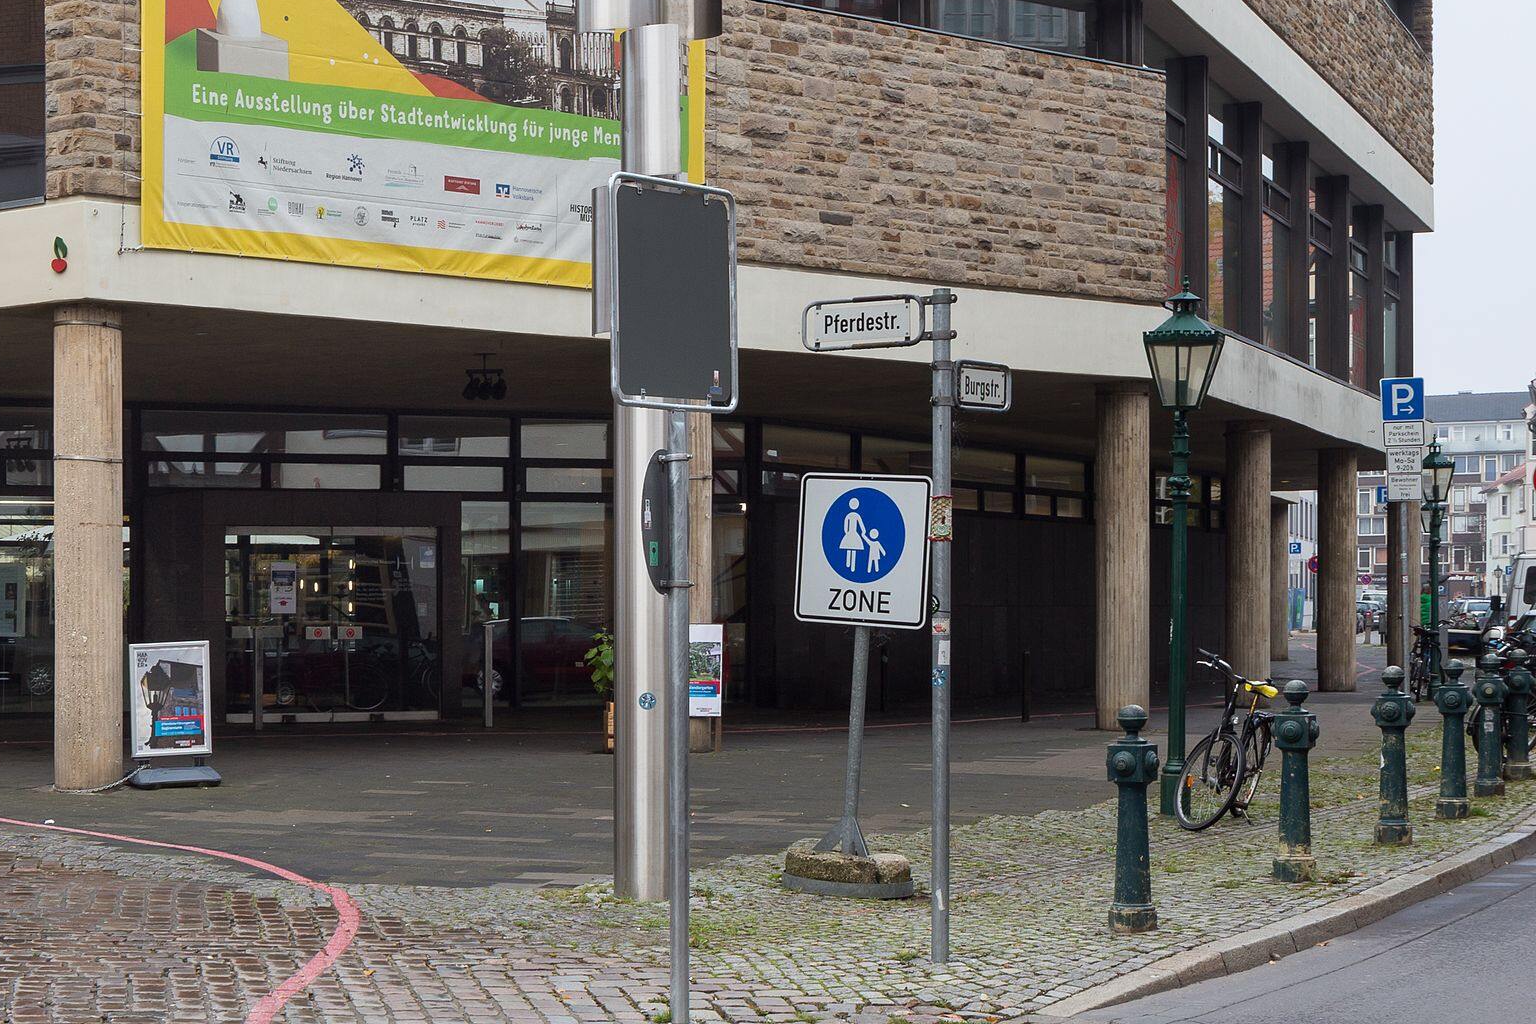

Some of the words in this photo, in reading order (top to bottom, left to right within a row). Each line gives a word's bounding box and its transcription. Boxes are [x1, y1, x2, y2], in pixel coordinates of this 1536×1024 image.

[191, 83, 228, 106] Eine
[234, 88, 332, 125] Ausstellung
[338, 100, 375, 122] über
[380, 103, 517, 143] Stadtentwicklung
[522, 119, 545, 139] für
[549, 122, 588, 148] junge
[217, 140, 234, 156] VR
[824, 311, 900, 335] Pferdestr.
[965, 375, 1001, 401] Burgstr.
[1391, 383, 1415, 416] P
[1389, 449, 1420, 457] werktags
[828, 587, 891, 614] ZONE
